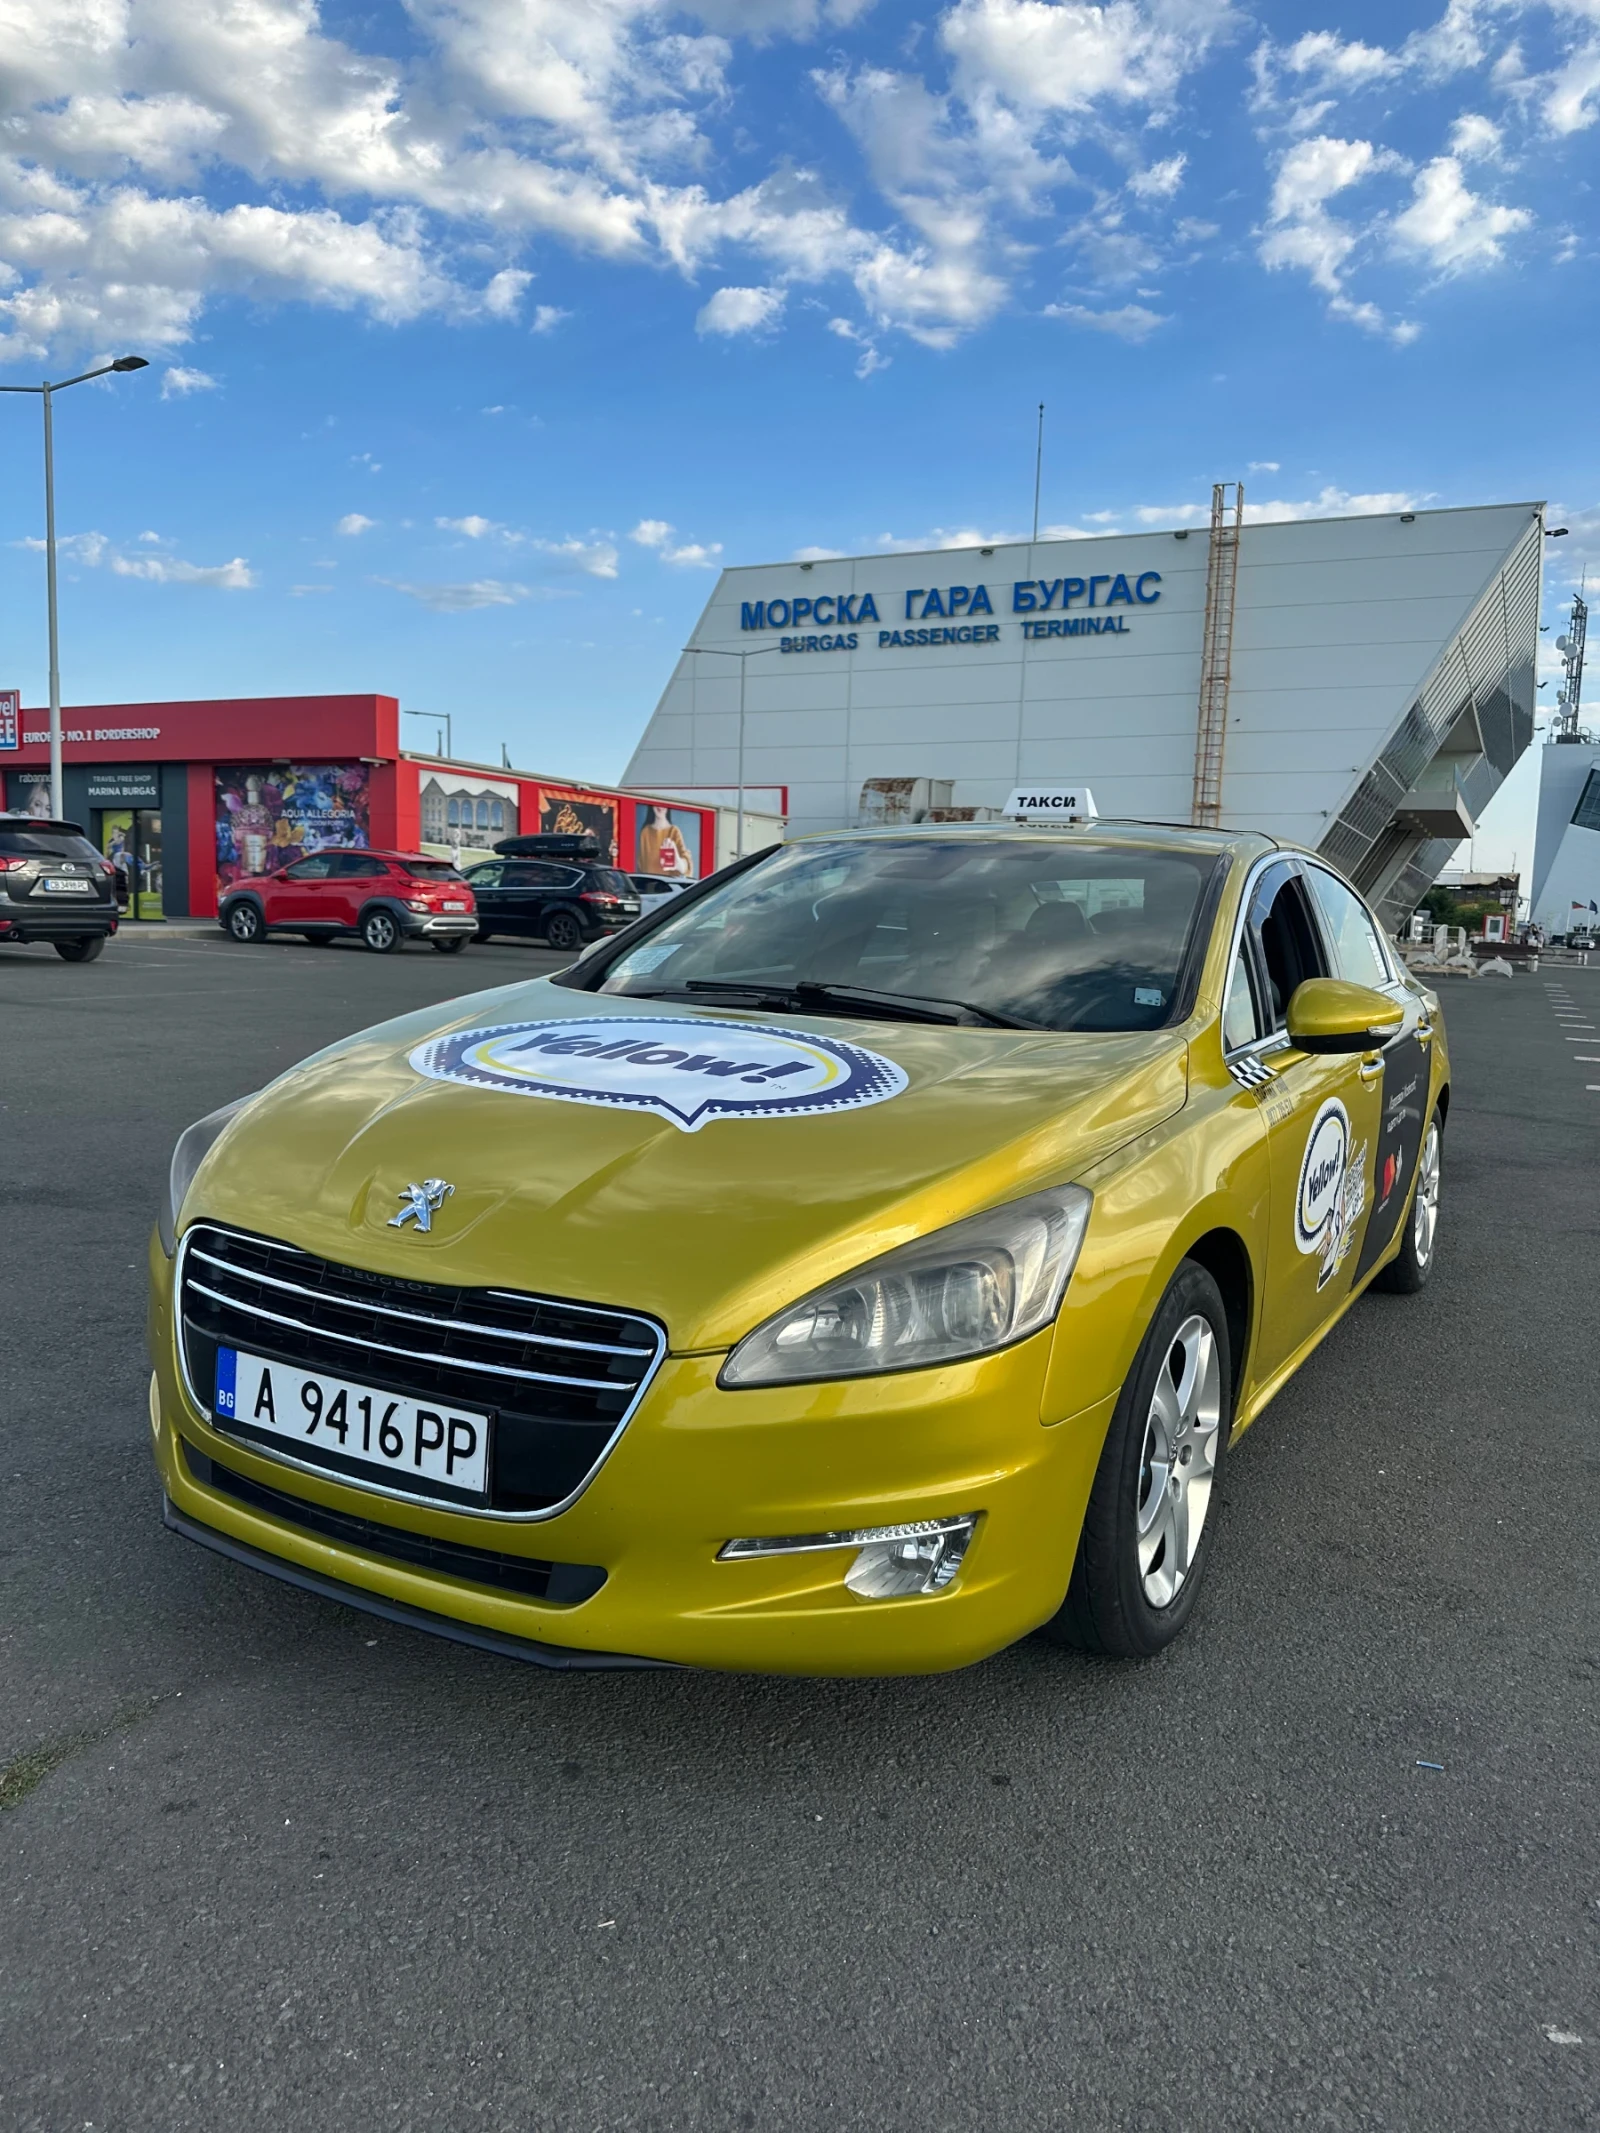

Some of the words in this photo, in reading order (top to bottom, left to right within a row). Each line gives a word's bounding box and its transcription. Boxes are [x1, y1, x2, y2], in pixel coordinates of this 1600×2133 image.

[741, 593, 880, 630] МОРСКА
[905, 584, 994, 619] ГАРА
[1012, 571, 1162, 613] БУРГАС
[780, 632, 858, 653] BURGAS
[878, 624, 1000, 648] PASSENGER
[1020, 615, 1130, 639] TERMINAL
[94, 728, 161, 741] BORDERSHOP
[93, 775, 116, 783] TRAVEL
[88, 787, 121, 796] MARINA
[122, 786, 156, 796] BURGAS
[1017, 796, 1076, 808] ТАКСИ
[281, 809, 306, 819] AQUA
[306, 809, 355, 819] ALLEGORIA
[507, 1033, 815, 1084] Yellow!
[1307, 1138, 1341, 1208] Yellow!
[341, 1266, 437, 1293] PEUGEOT
[218, 1389, 234, 1408] BG
